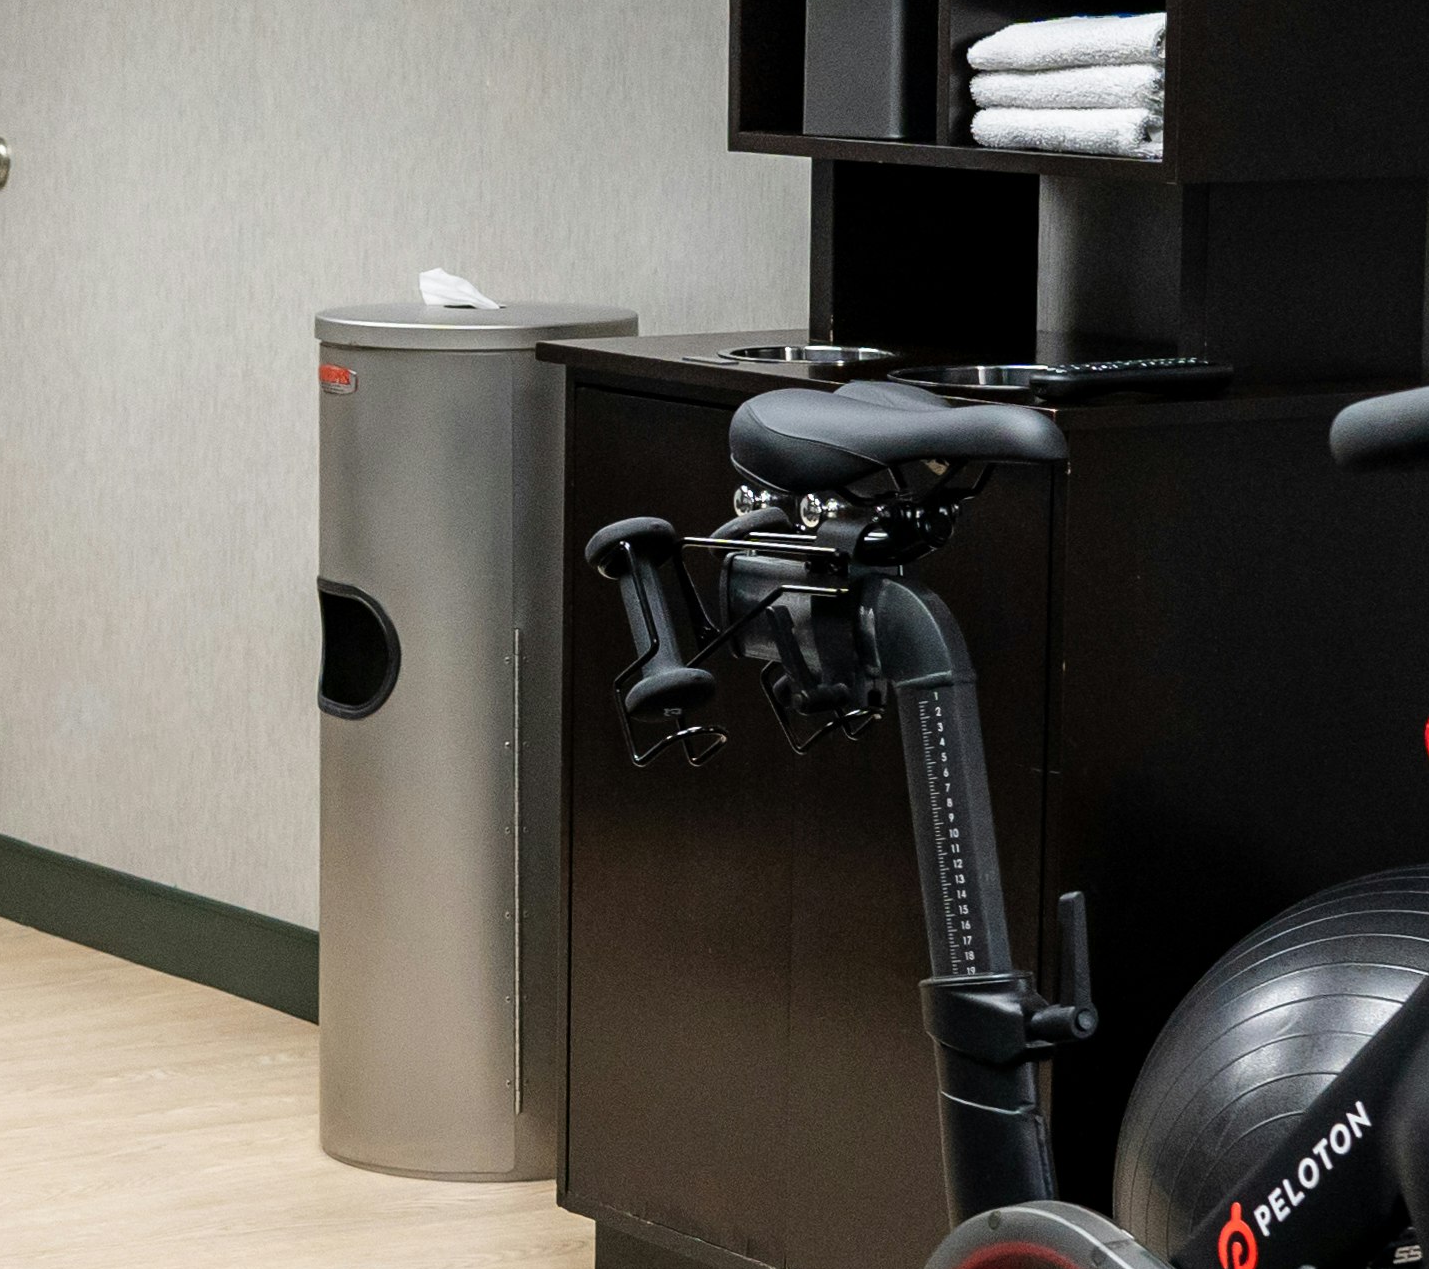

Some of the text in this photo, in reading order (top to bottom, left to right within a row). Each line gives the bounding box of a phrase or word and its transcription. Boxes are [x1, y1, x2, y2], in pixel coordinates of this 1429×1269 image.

[935, 707, 941, 716] 2
[937, 723, 943, 732] 3
[939, 738, 945, 746] 4
[941, 752, 947, 762] 5
[943, 768, 949, 777] 6
[945, 783, 951, 792] 7
[947, 798, 953, 808] 8
[948, 813, 955, 822] 9
[949, 829, 959, 838] 10
[951, 844, 960, 853] 11
[953, 859, 963, 869] 12
[955, 874, 965, 884] 13
[957, 890, 967, 899] 14
[959, 905, 969, 914] 15
[961, 921, 971, 930] 16
[963, 936, 972, 945] 17
[965, 951, 975, 961] 18
[1253, 1100, 1372, 1237] PELOTON
